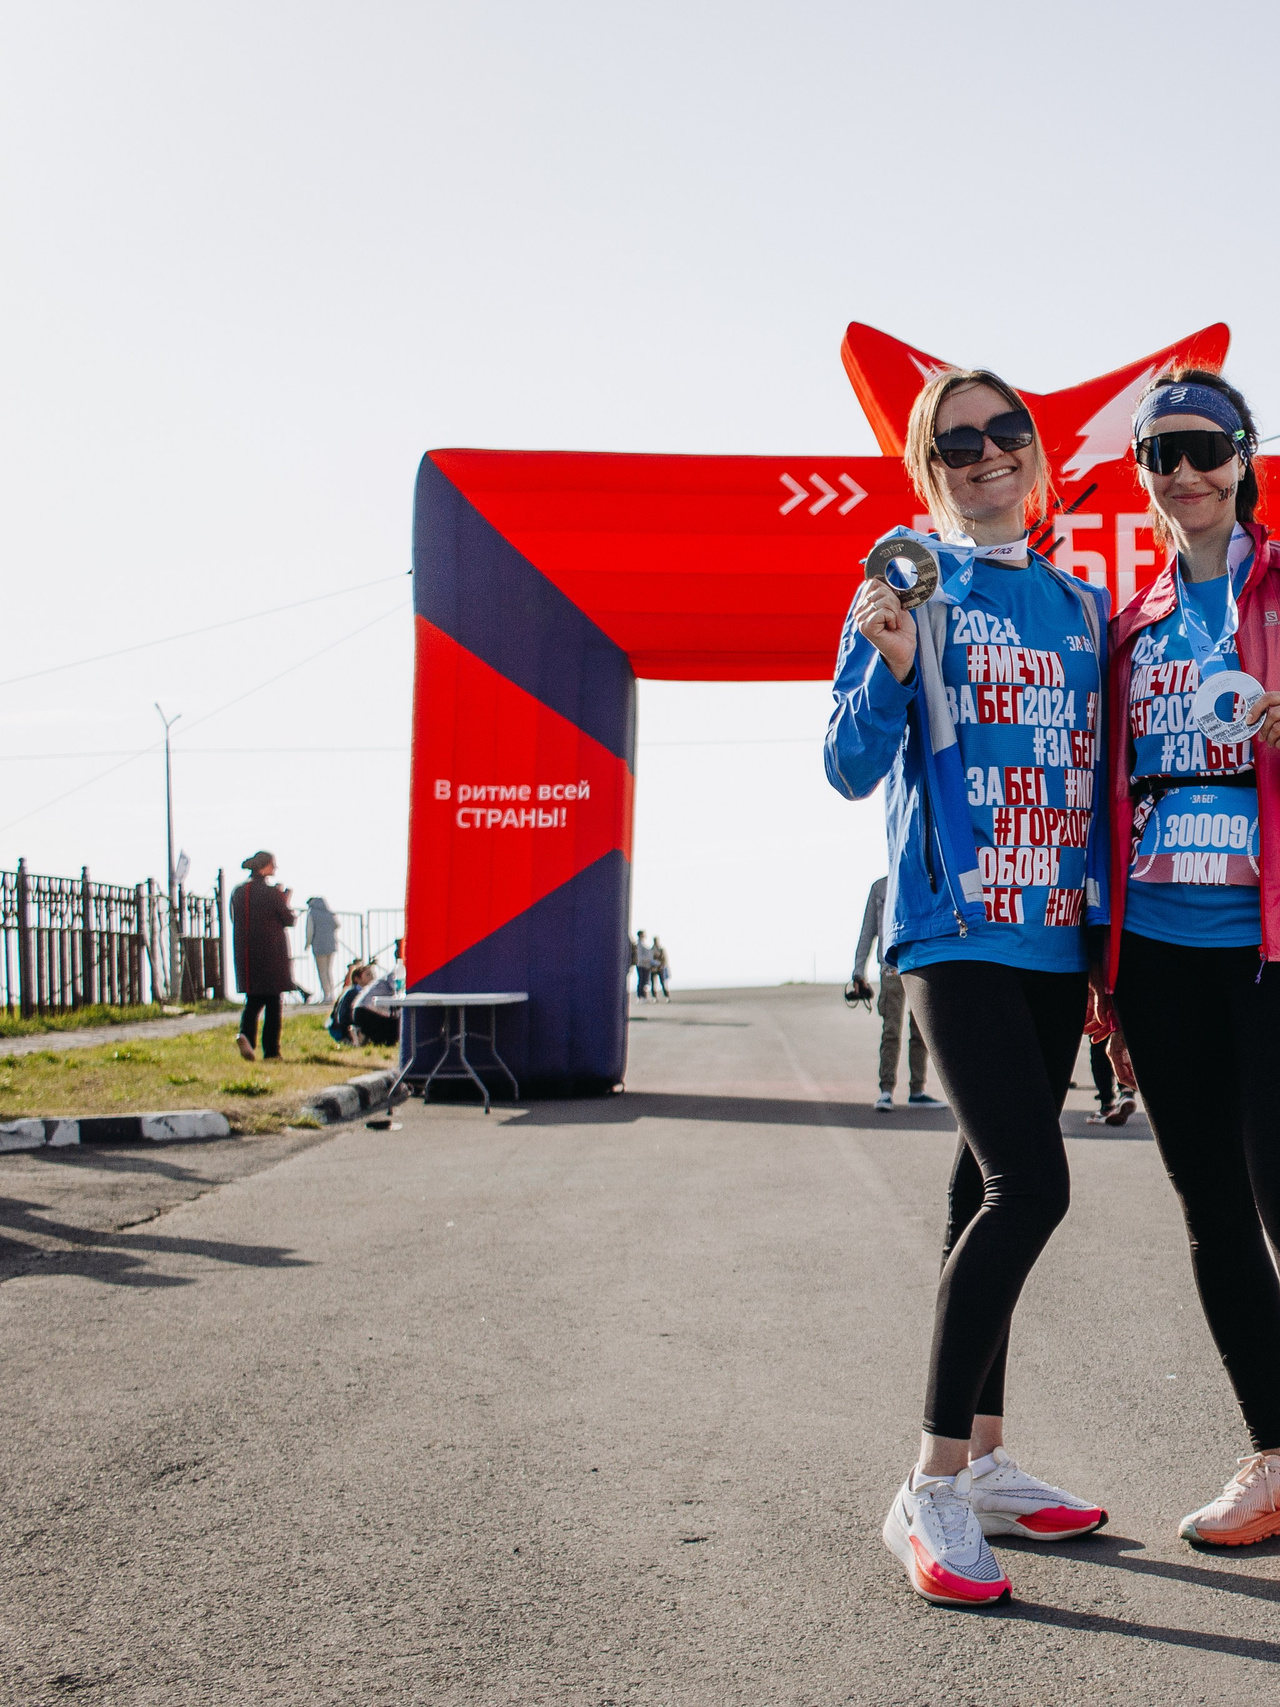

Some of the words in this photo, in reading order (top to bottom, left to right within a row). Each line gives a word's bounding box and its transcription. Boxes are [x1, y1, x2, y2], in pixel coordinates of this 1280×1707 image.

[952, 605, 1021, 645] 2024
[967, 645, 1066, 688] #МЕЧТА
[1130, 635, 1169, 665] 024
[434, 779, 452, 800] В
[457, 784, 532, 804] ритме
[537, 780, 591, 801] всей
[967, 766, 1048, 807] ЗАБЕГ
[456, 806, 567, 829] СТРАНЫ!
[1163, 813, 1249, 849] 30009
[1172, 851, 1228, 884] 10КМ
